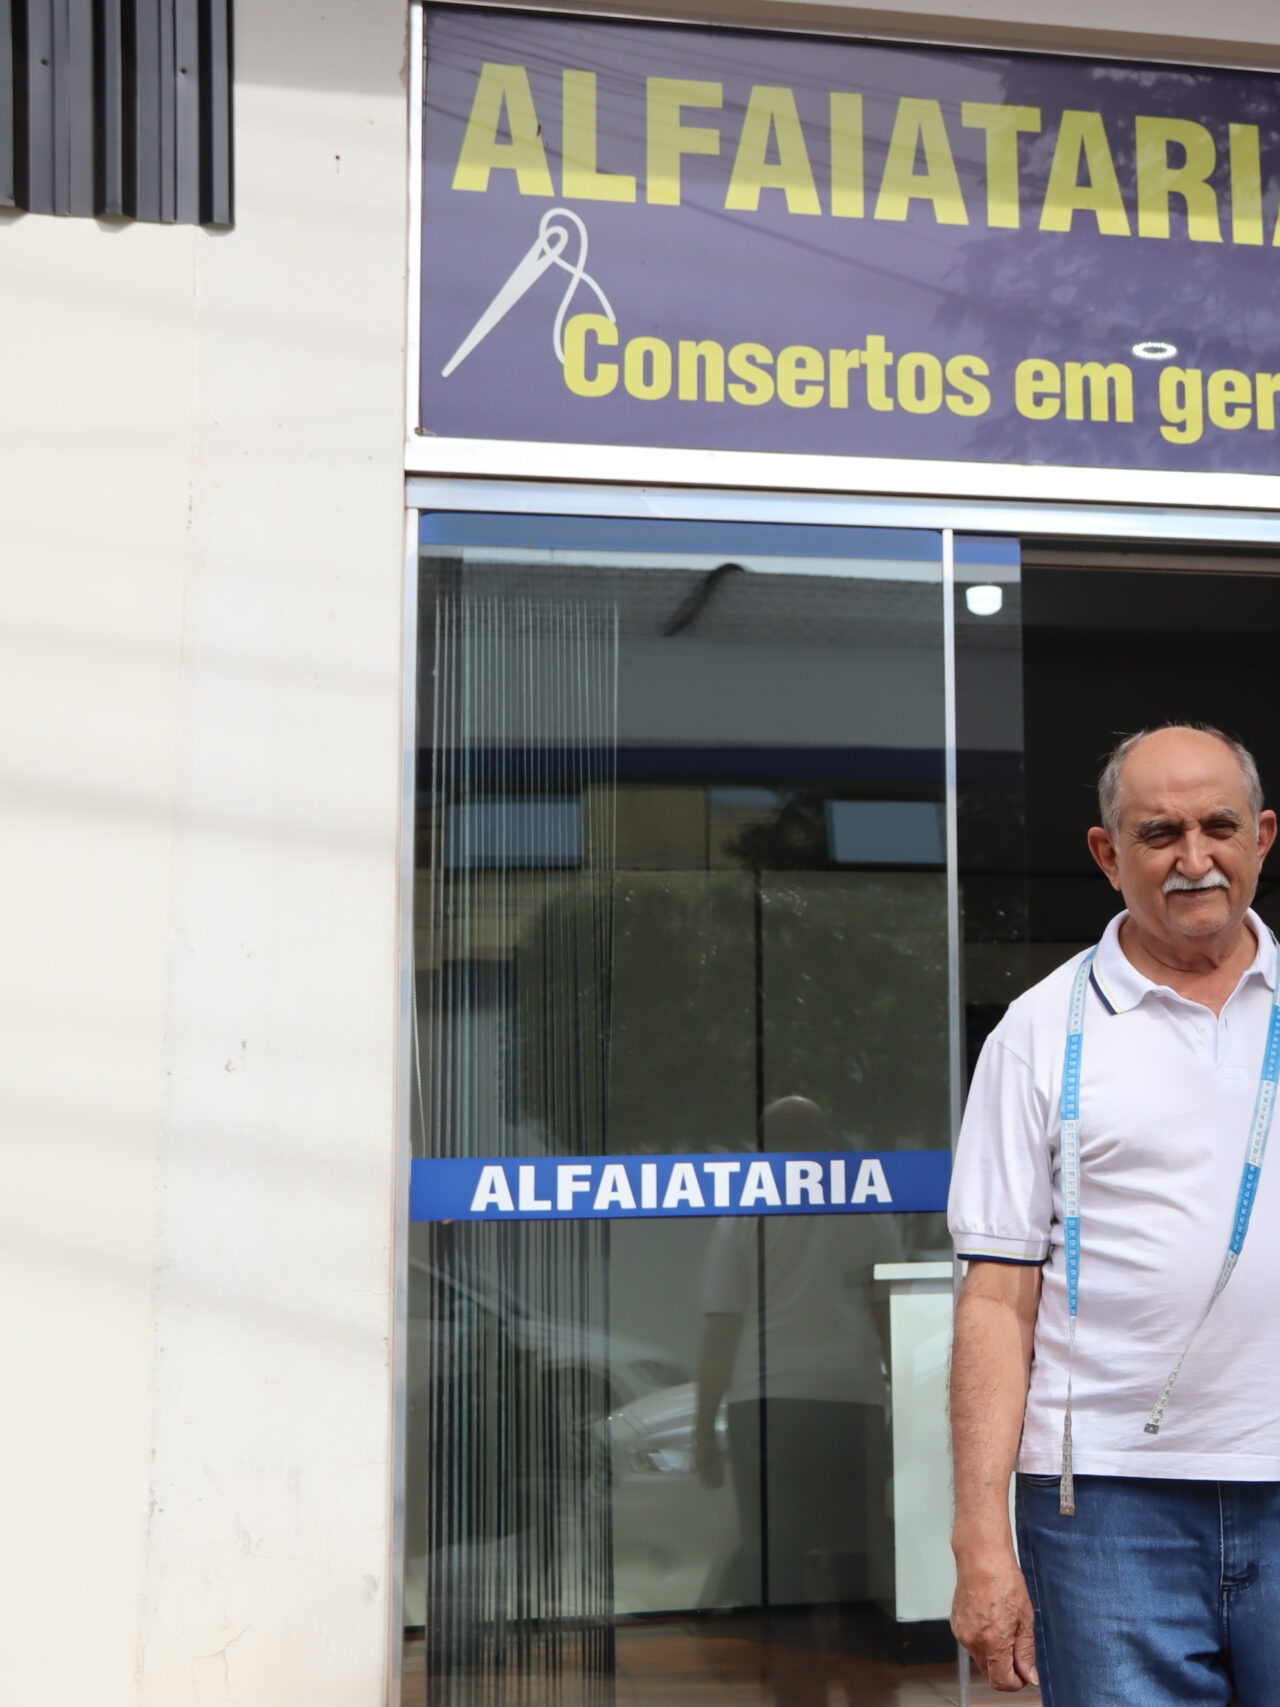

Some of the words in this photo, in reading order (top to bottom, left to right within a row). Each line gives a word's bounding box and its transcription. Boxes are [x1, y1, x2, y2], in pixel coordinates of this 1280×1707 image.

[563, 313, 991, 417] Consertos
[1014, 357, 1134, 423] em
[470, 1159, 893, 1212] ALFAIATARIA
